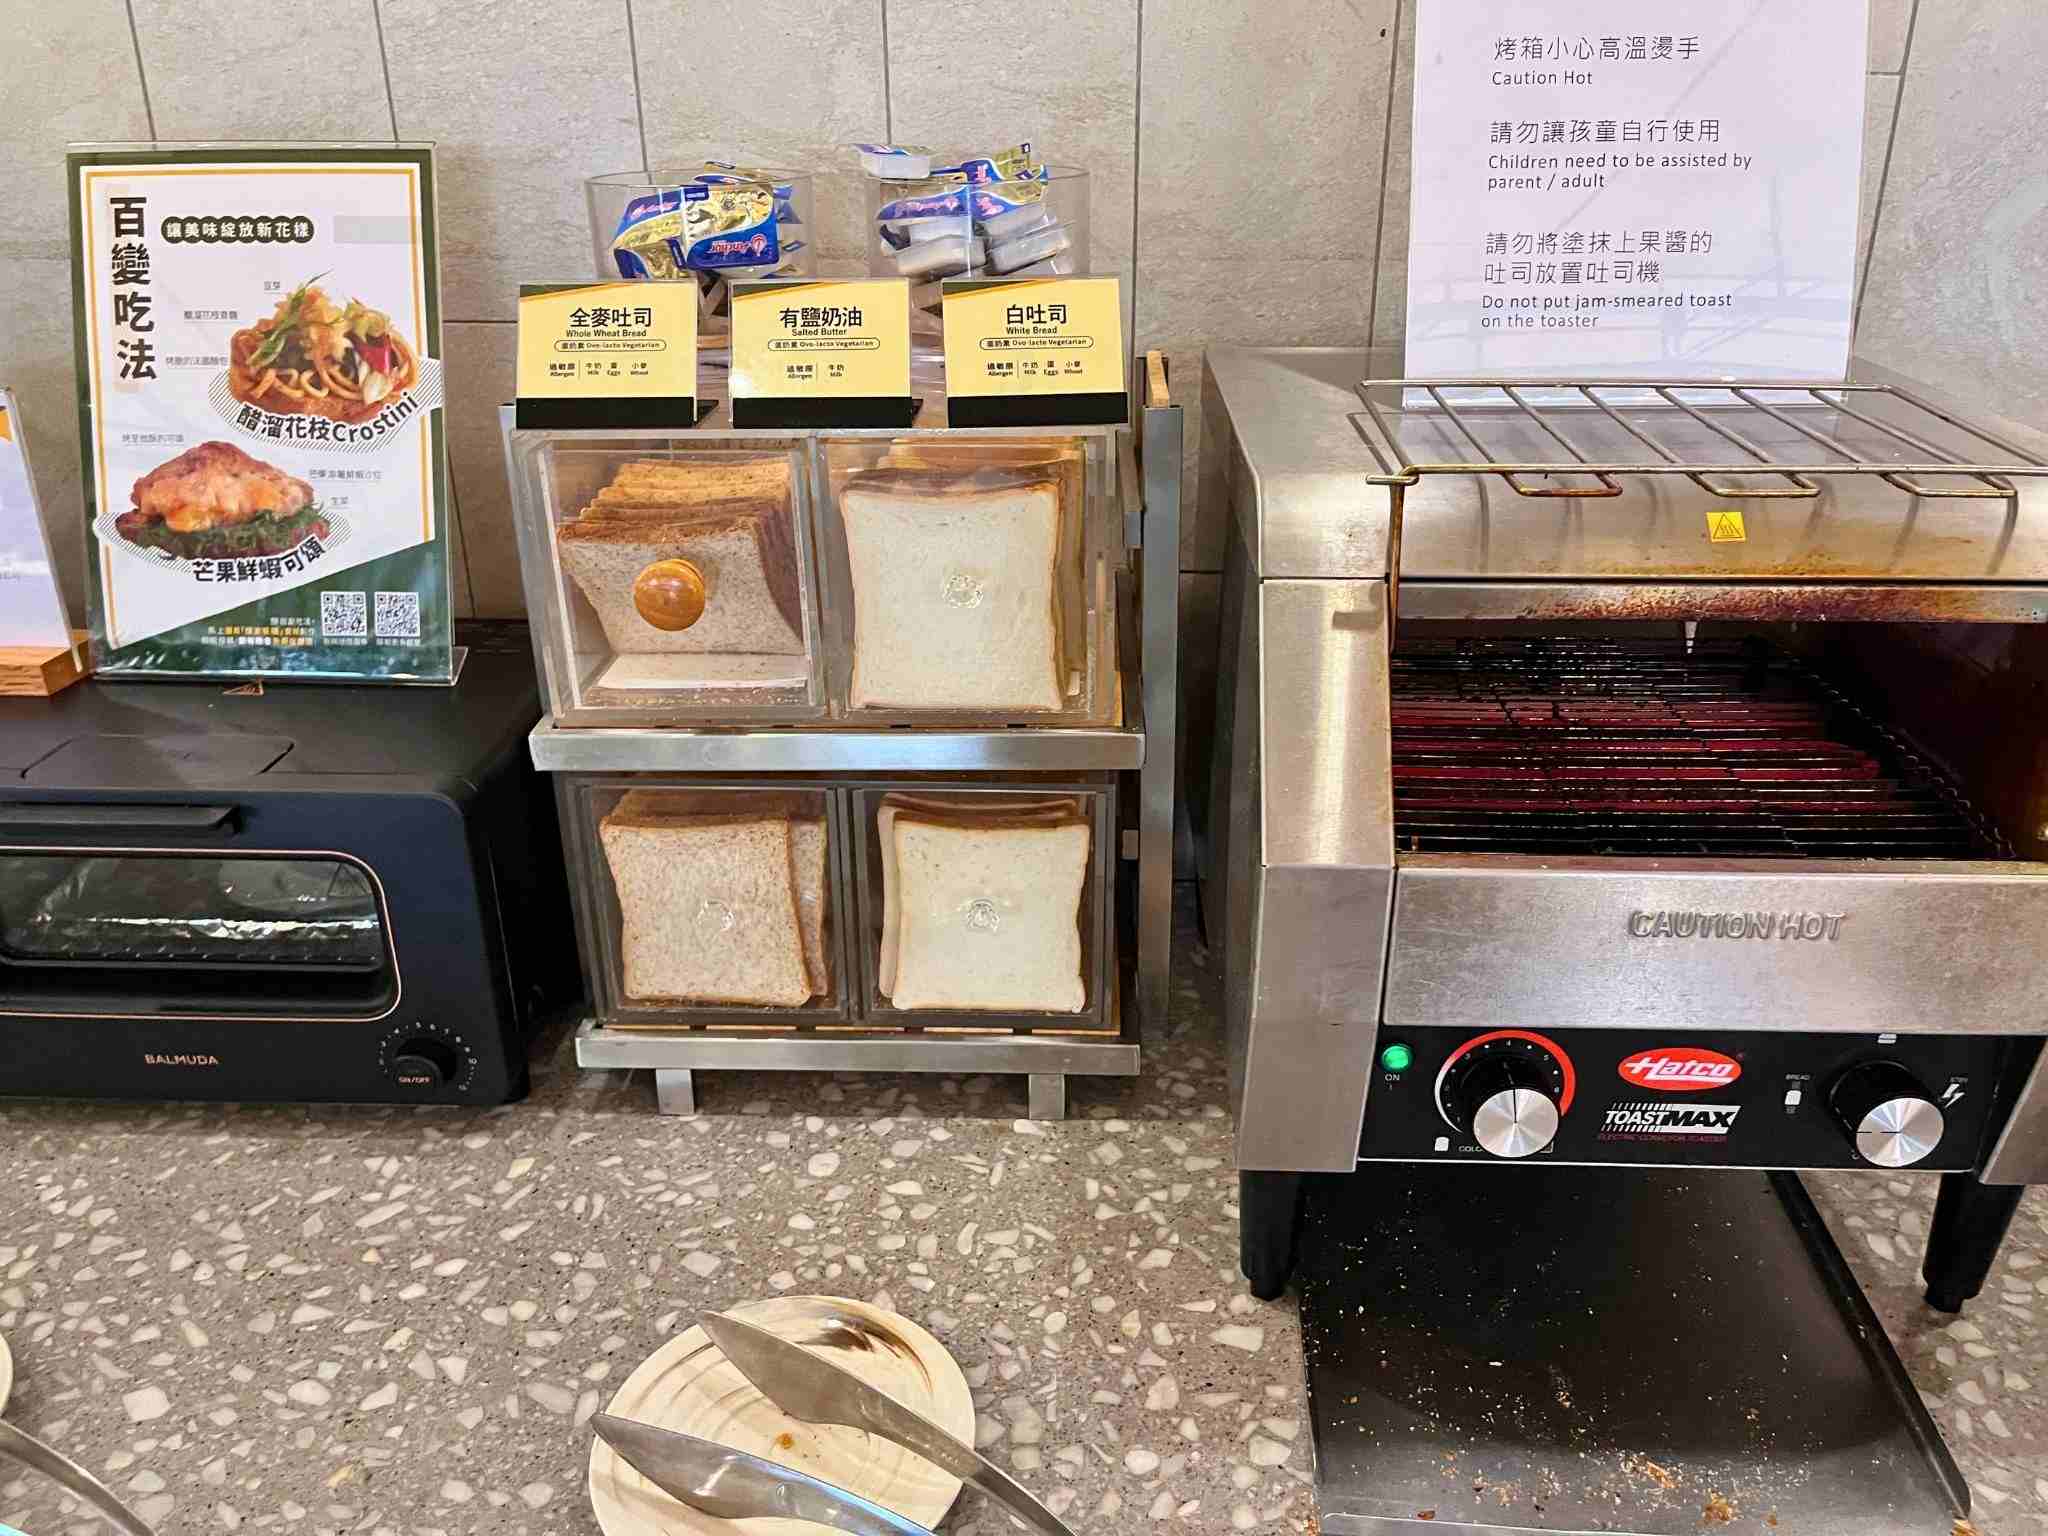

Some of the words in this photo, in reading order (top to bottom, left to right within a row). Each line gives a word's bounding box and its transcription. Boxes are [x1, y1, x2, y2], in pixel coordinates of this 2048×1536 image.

[1494, 36, 1701, 61] 烤箱小心高溫燙手
[1492, 70, 1557, 85] Caution
[1564, 70, 1592, 85] Hot
[1490, 119, 1720, 144] 請勿讓孩童自行使用
[1488, 154, 1558, 169] Children
[1565, 153, 1606, 168] need
[1612, 155, 1629, 168] to
[1635, 153, 1655, 167] be
[1661, 152, 1727, 167] assisted
[1733, 152, 1752, 170] by
[1488, 177, 1542, 191] parent
[1546, 174, 1557, 191] /
[1561, 173, 1605, 188] adult
[165, 221, 311, 239] 讓美味綻放新花樣
[1485, 230, 1713, 255] 請勿將塗抹上果醬的
[1484, 260, 1662, 285] 吐司放置吐司機
[110, 196, 158, 380] 百變吃法
[1482, 295, 1504, 309] Do
[1510, 296, 1537, 309] not
[1543, 296, 1570, 312] put
[1575, 293, 1684, 312] jam-smeared
[1690, 293, 1733, 307] toast
[569, 307, 651, 328] 全麥吐司
[779, 306, 862, 328] 有鹽奶油
[1006, 304, 1067, 324] 白吐司
[1481, 316, 1501, 328] on
[1508, 313, 1534, 328] the
[1541, 314, 1600, 328] toaster
[566, 329, 592, 337] Whole
[593, 329, 620, 337] Wheat
[622, 329, 647, 337] Bread
[791, 328, 819, 337] Salted
[821, 328, 848, 336] Butter
[1006, 326, 1030, 335] White
[1033, 326, 1058, 334] Bread
[192, 536, 325, 582] 芒果鮮蝦可頌
[1629, 911, 1776, 939] CAUTION
[1778, 911, 1847, 941] HOT
[144, 1054, 219, 1065] BALMUDA
[1384, 1073, 1401, 1082] ON
[1624, 1057, 1736, 1083] Hatco
[1604, 1109, 1737, 1129] TOASTMAX
